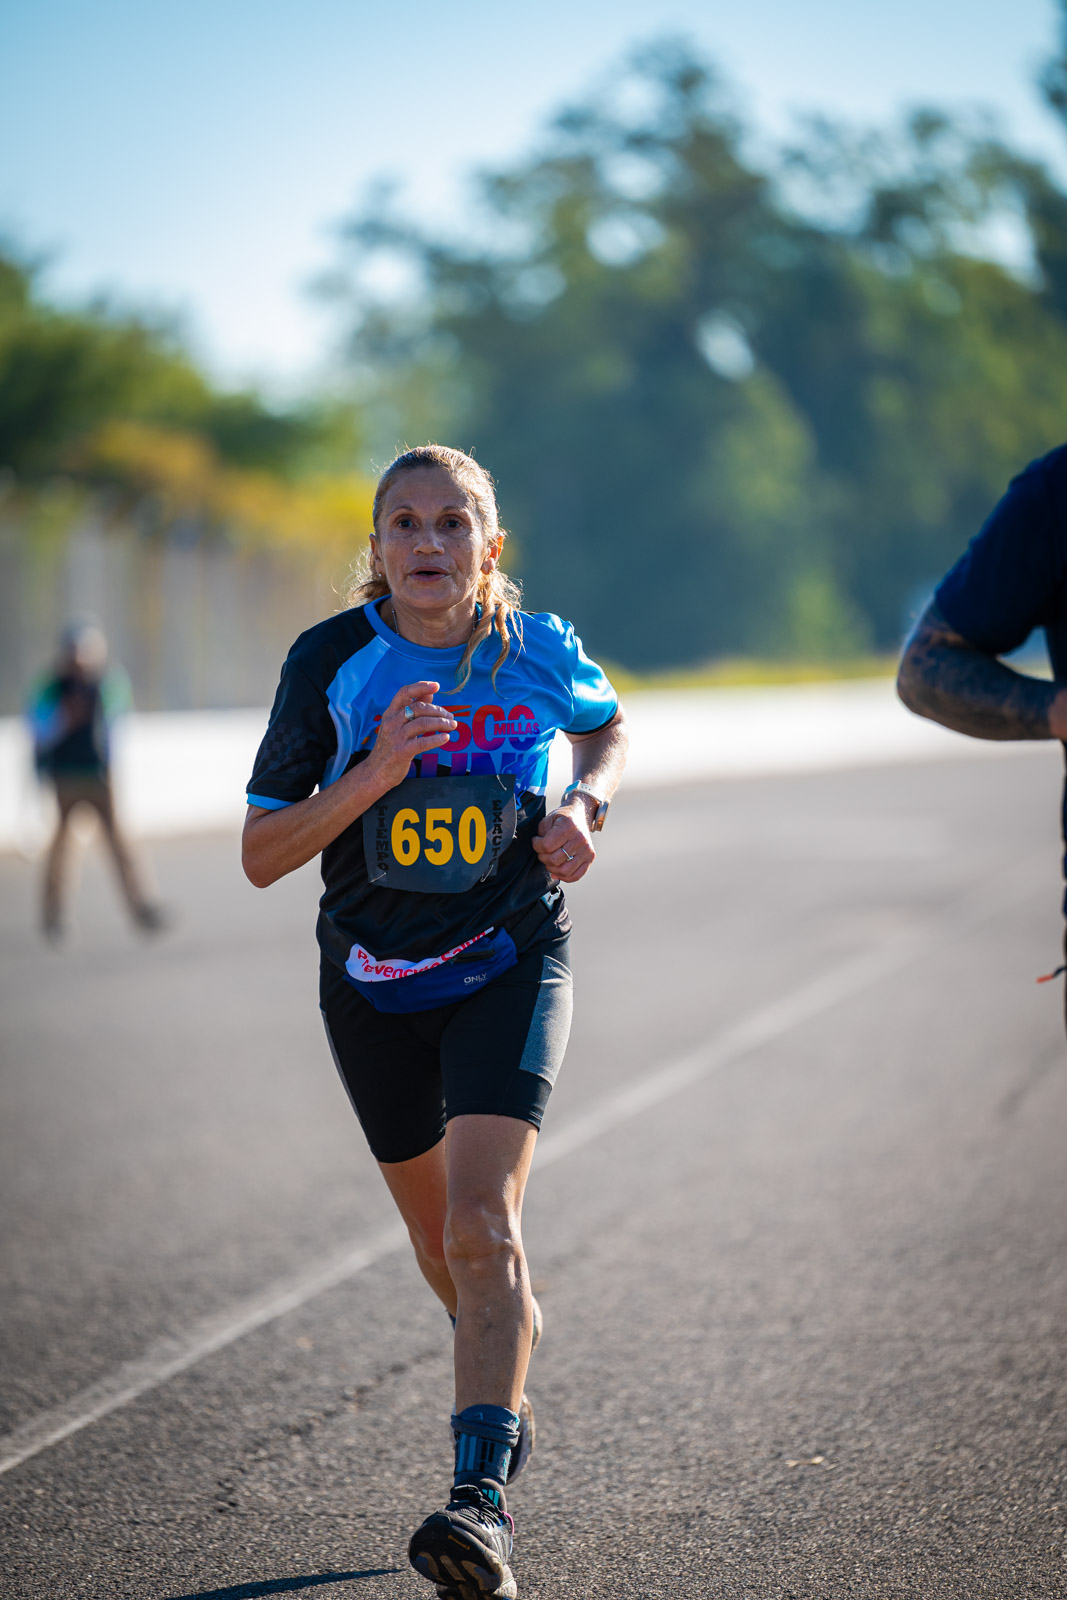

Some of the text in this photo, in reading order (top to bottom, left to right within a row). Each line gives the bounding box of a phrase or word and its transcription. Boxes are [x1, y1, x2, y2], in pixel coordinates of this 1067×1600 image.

[494, 722, 540, 736] MILLAS
[375, 805, 389, 871] TIEMPO
[391, 806, 487, 867] 650
[463, 972, 487, 985] ONLY
